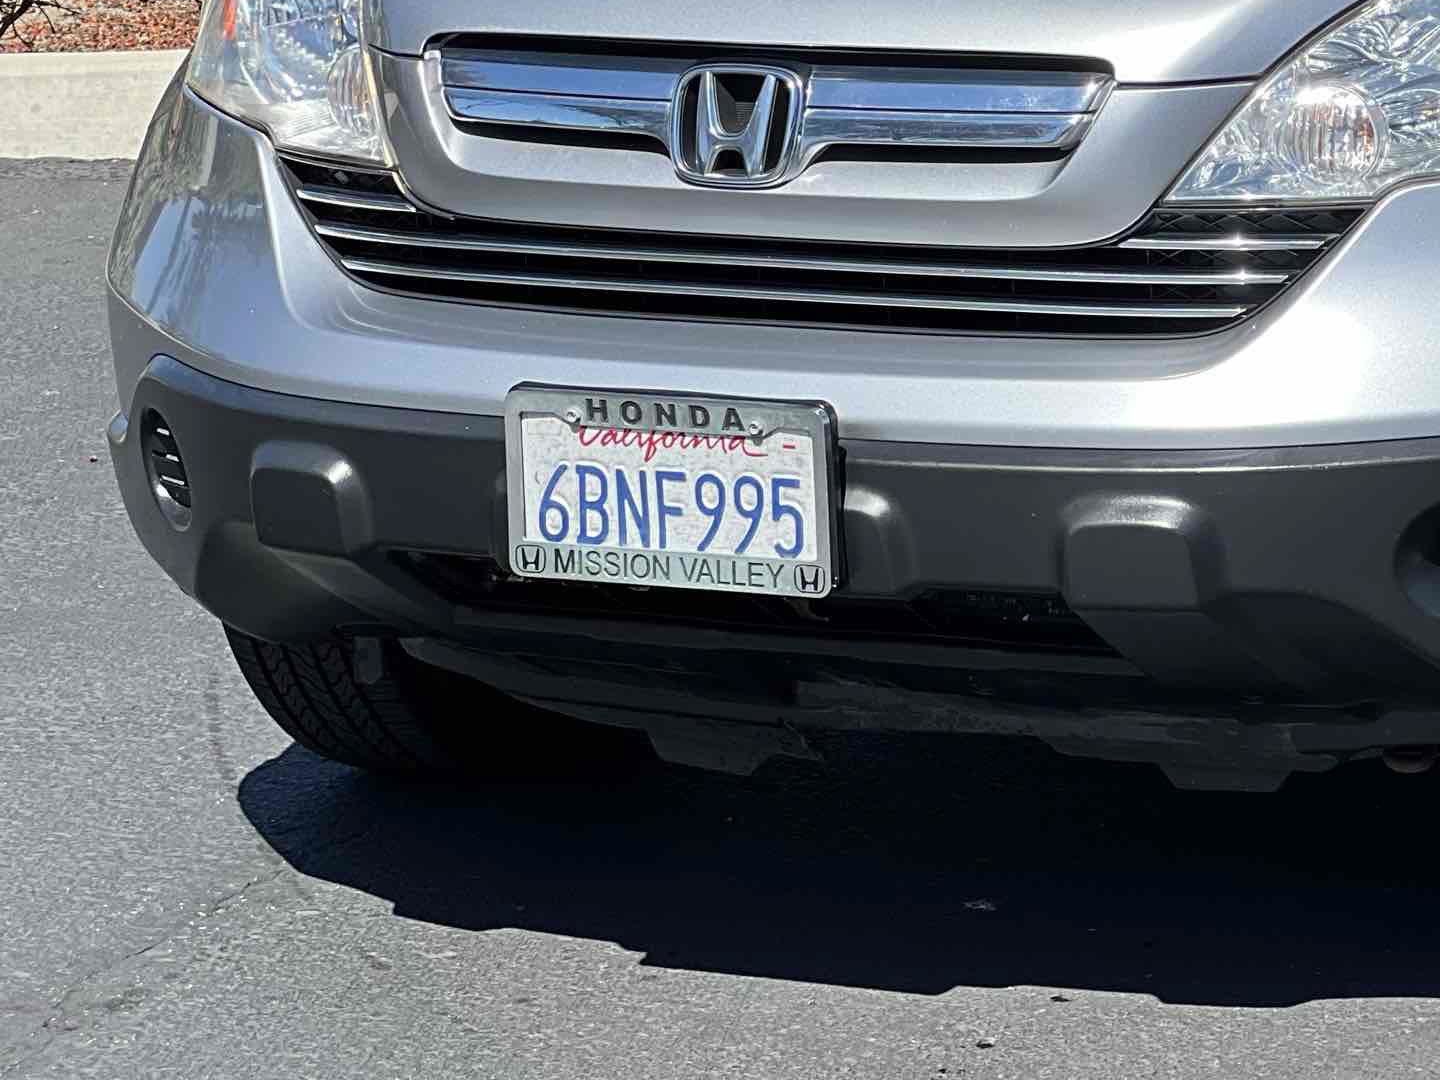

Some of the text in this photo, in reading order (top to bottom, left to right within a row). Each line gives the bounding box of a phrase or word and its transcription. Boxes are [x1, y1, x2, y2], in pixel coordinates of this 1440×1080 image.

[585, 398, 746, 432] HONDA
[538, 464, 805, 558] 6BNF995
[554, 548, 671, 580] MISSION
[679, 556, 785, 588] VALLEY
